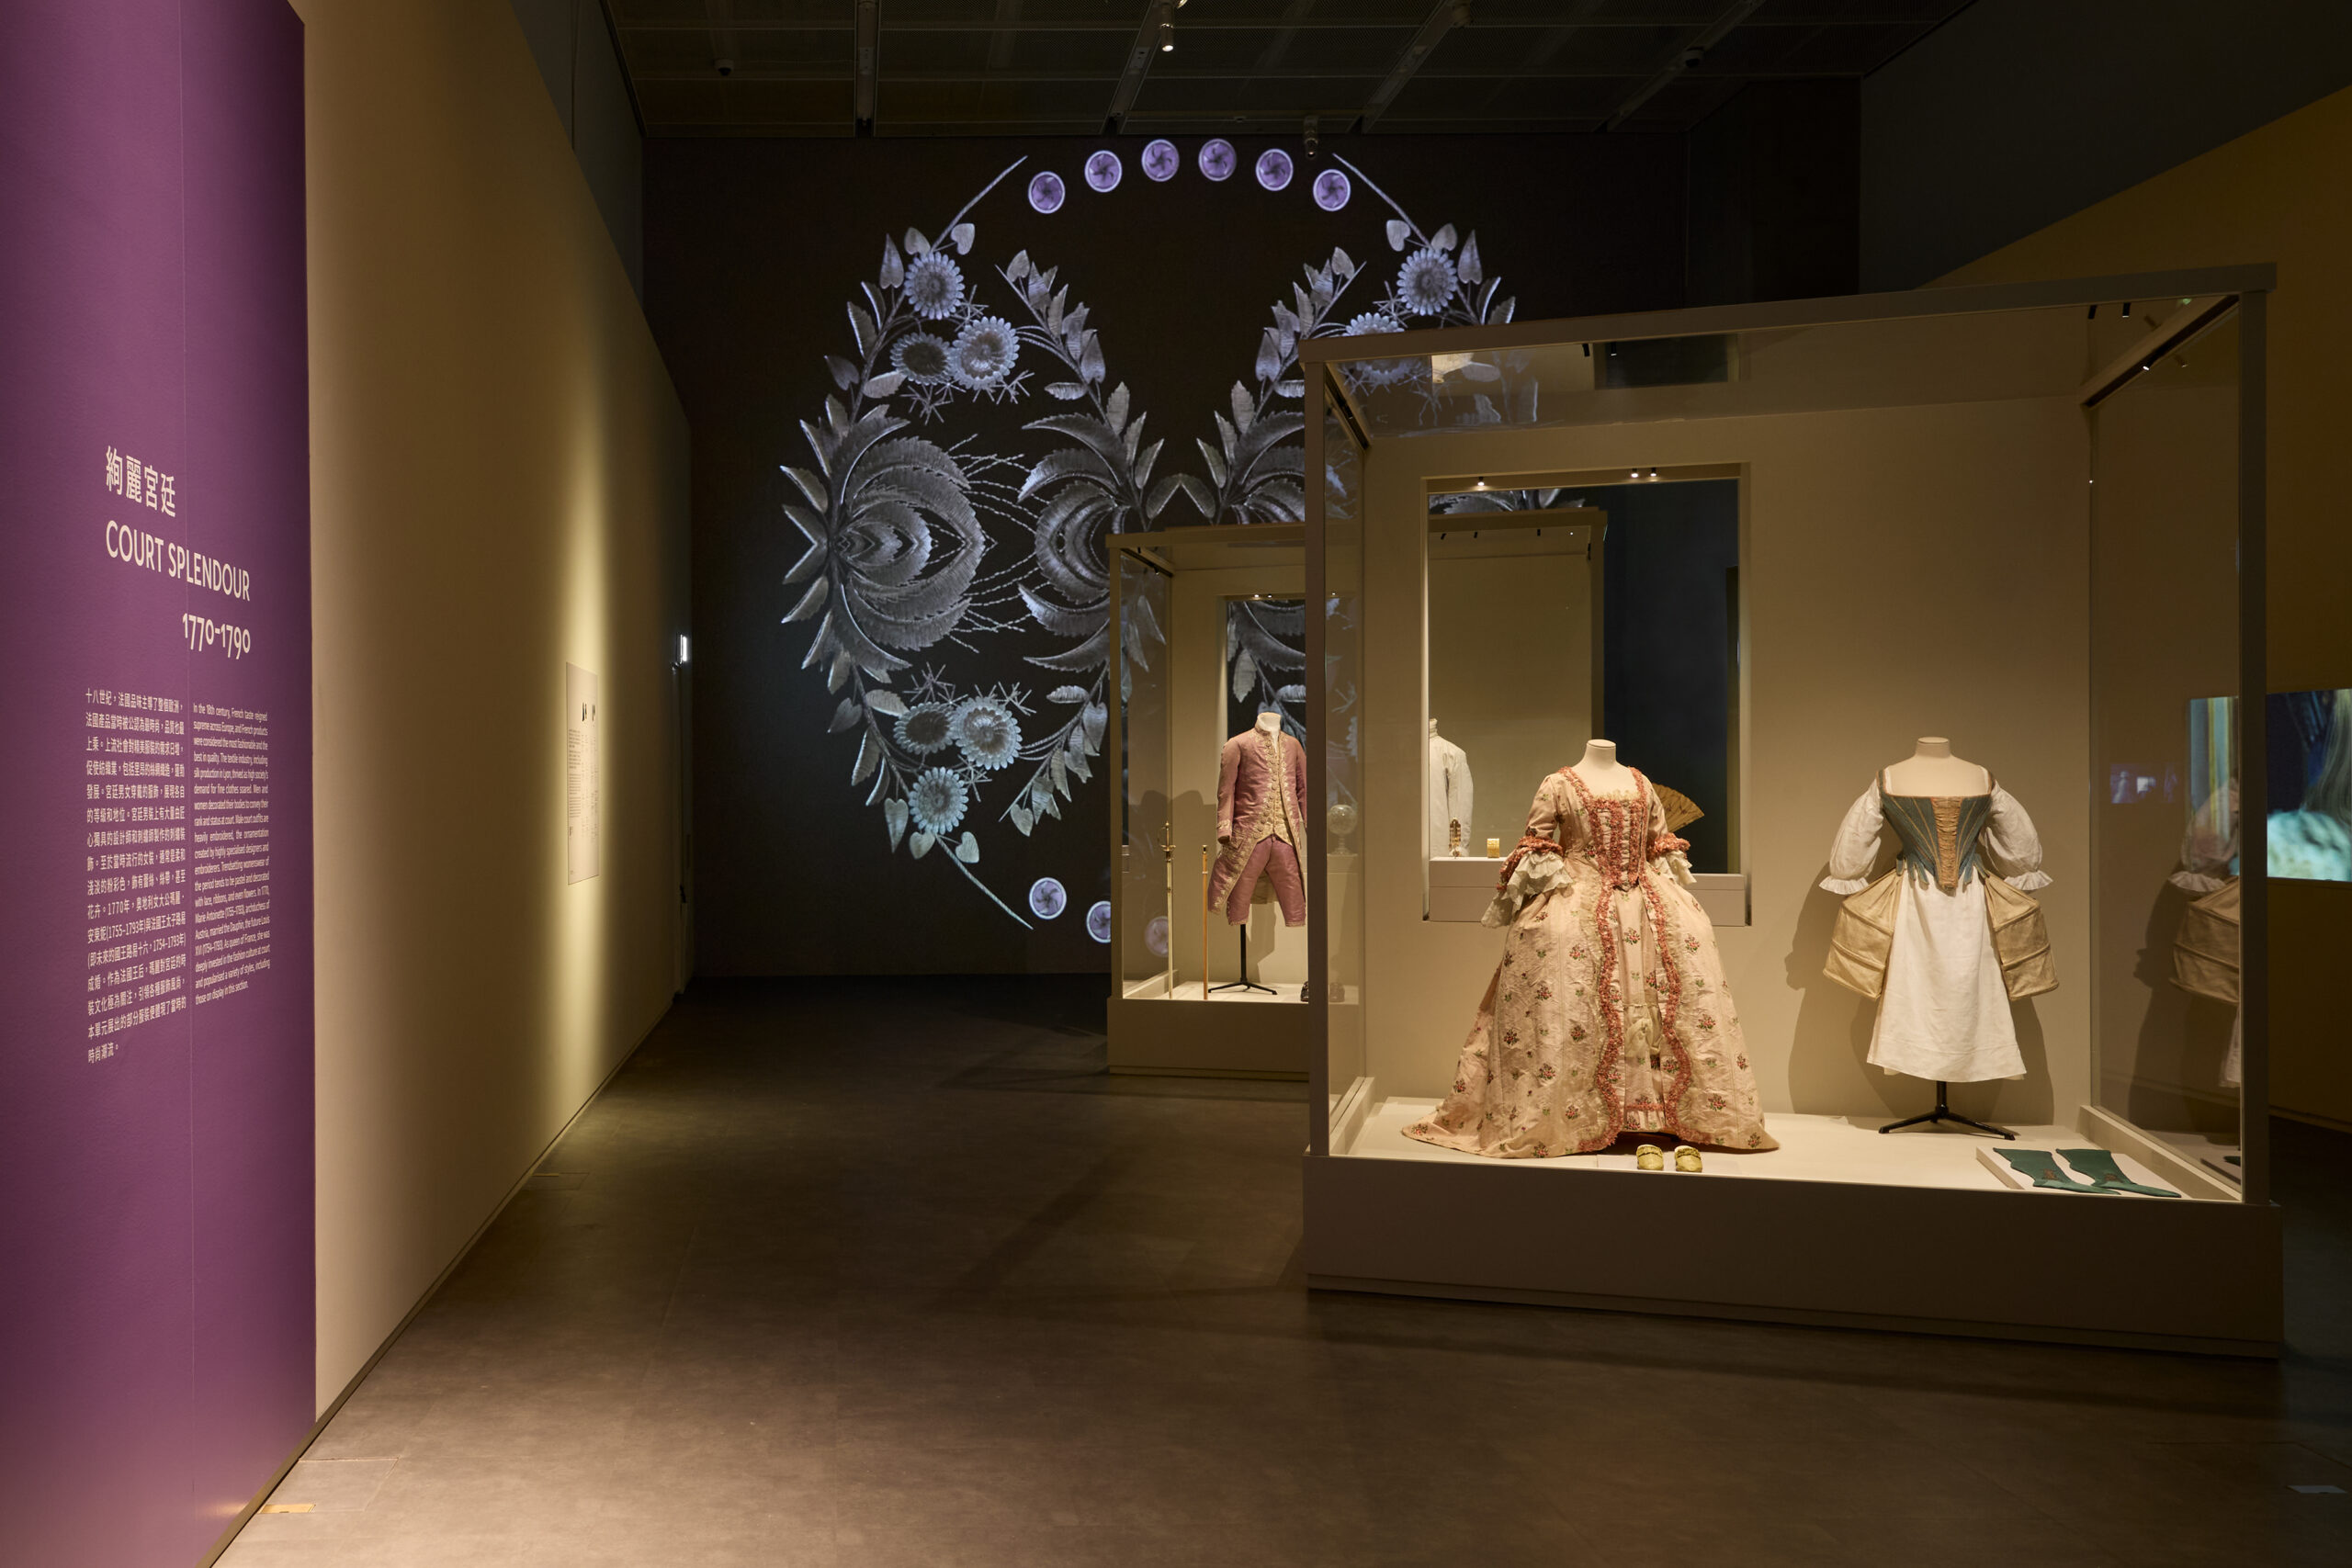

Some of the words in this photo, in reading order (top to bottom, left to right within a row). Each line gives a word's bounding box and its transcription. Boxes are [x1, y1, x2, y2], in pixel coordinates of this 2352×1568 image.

[106, 445, 176, 518] 絢麗宮廷
[106, 520, 164, 572] COURT
[168, 542, 250, 602] SPLENDOUR
